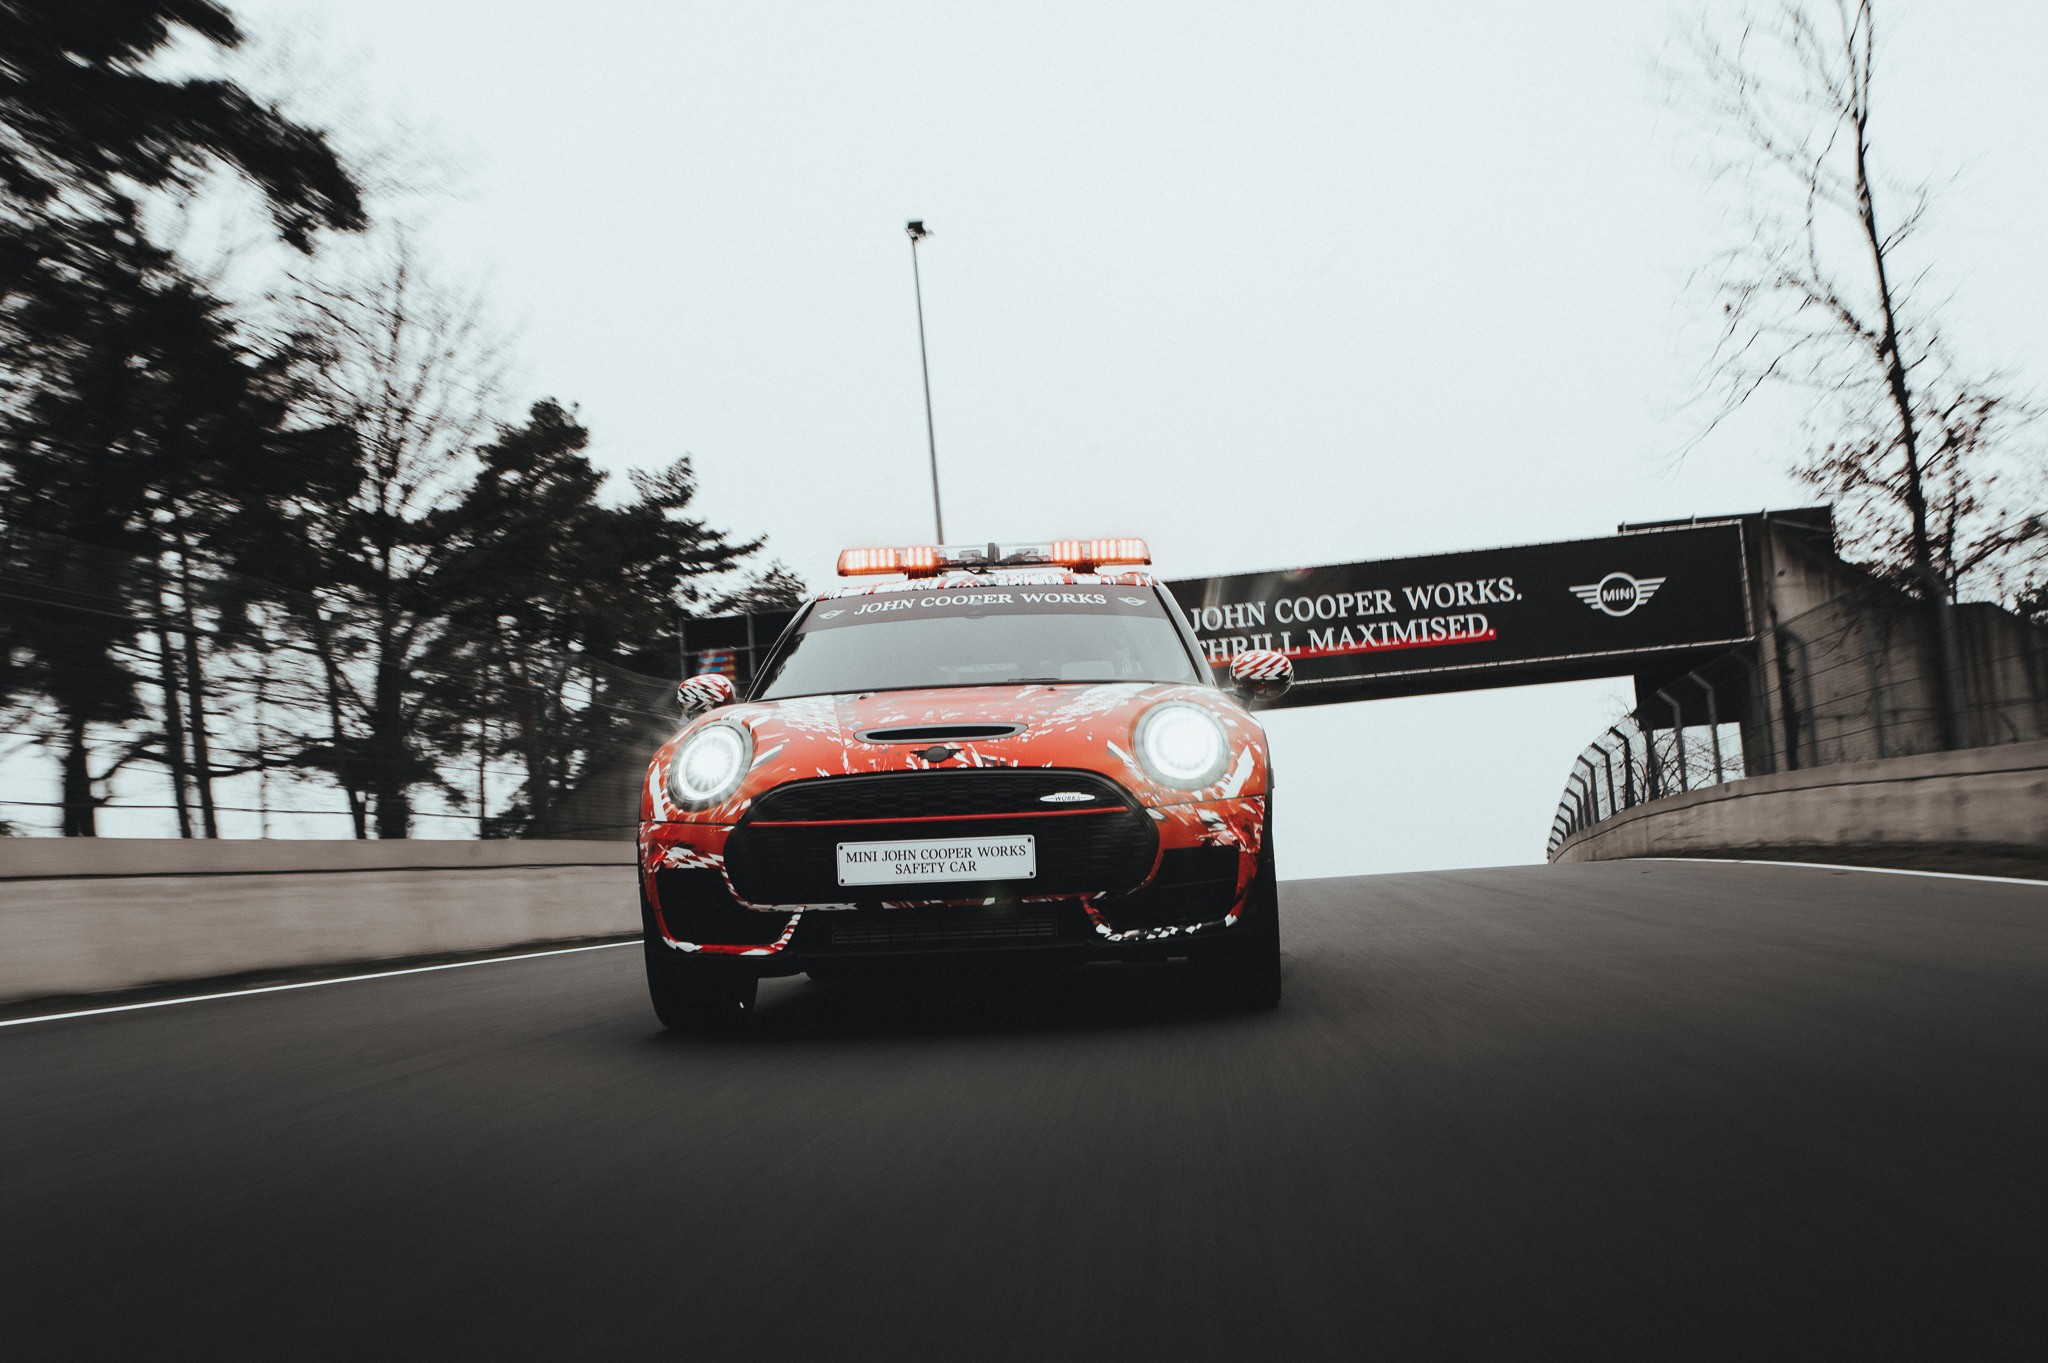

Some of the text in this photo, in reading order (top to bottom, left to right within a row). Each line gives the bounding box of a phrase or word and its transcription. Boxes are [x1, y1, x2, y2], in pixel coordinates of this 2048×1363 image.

[853, 592, 1108, 615] JOHN COOPER WORKS
[1190, 576, 1523, 633] JOHN COOPER WORKS.
[1602, 586, 1635, 602] MINI
[1307, 613, 1495, 654] MAXIMISED.
[846, 844, 1027, 864] MINI JOHN COOPER WORKS
[895, 860, 977, 875] SAFETY CAR
